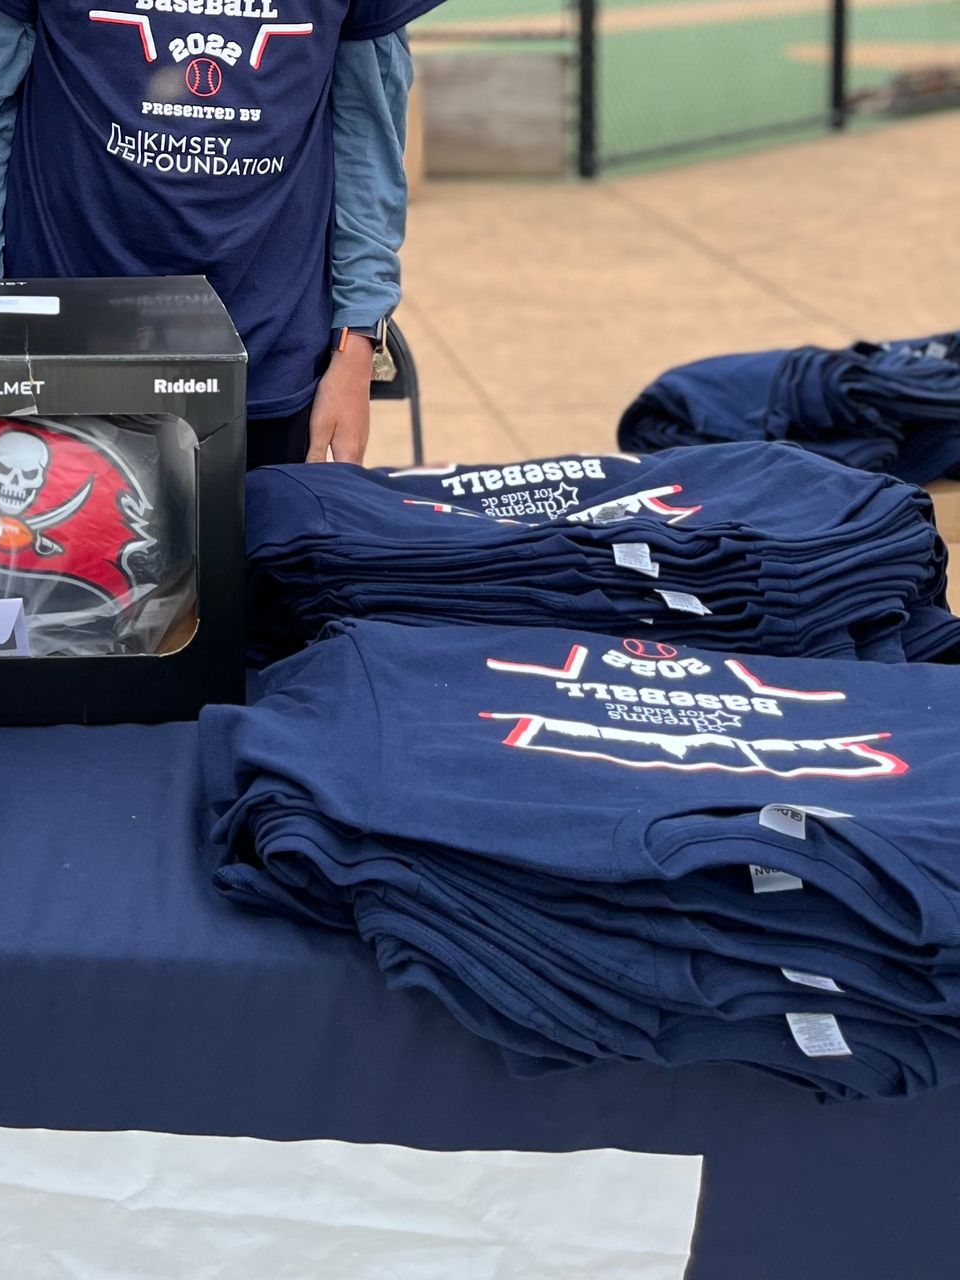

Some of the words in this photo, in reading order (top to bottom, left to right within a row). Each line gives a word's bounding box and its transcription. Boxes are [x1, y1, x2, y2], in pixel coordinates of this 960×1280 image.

[168, 32, 243, 66] 2022
[143, 131, 231, 156] KIMSEY
[142, 152, 285, 176] FOUNDATION
[154, 378, 219, 394] Riddell
[481, 494, 498, 507] dc
[502, 488, 532, 504] kids
[534, 487, 553, 499] for
[485, 500, 557, 519] dreams
[601, 649, 712, 678] 2022
[605, 702, 628, 712] dc
[635, 704, 673, 718] kids
[678, 708, 704, 719] for
[608, 710, 708, 730] dreams
